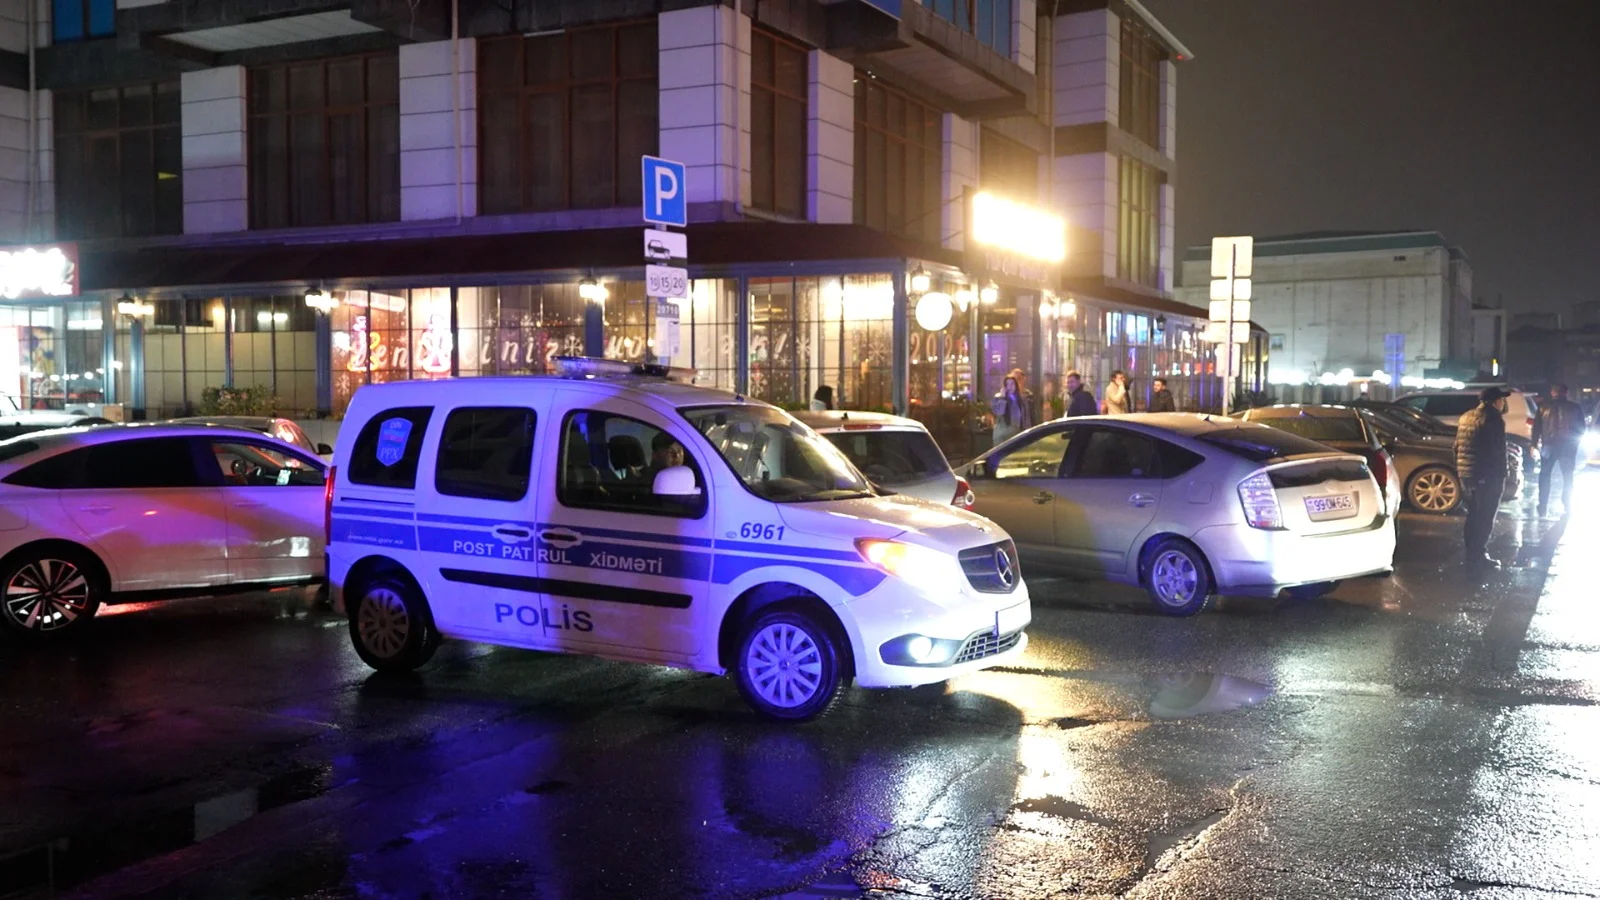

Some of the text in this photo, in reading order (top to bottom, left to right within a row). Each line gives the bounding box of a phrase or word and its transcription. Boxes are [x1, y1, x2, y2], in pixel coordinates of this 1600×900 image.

[655, 166, 678, 216] P
[661, 276, 671, 289] 15
[673, 277, 684, 289] 20
[740, 522, 785, 541] 6961
[453, 540, 663, 573] POST PATRUL XİDMƏTİ
[494, 603, 594, 632] POLİS
